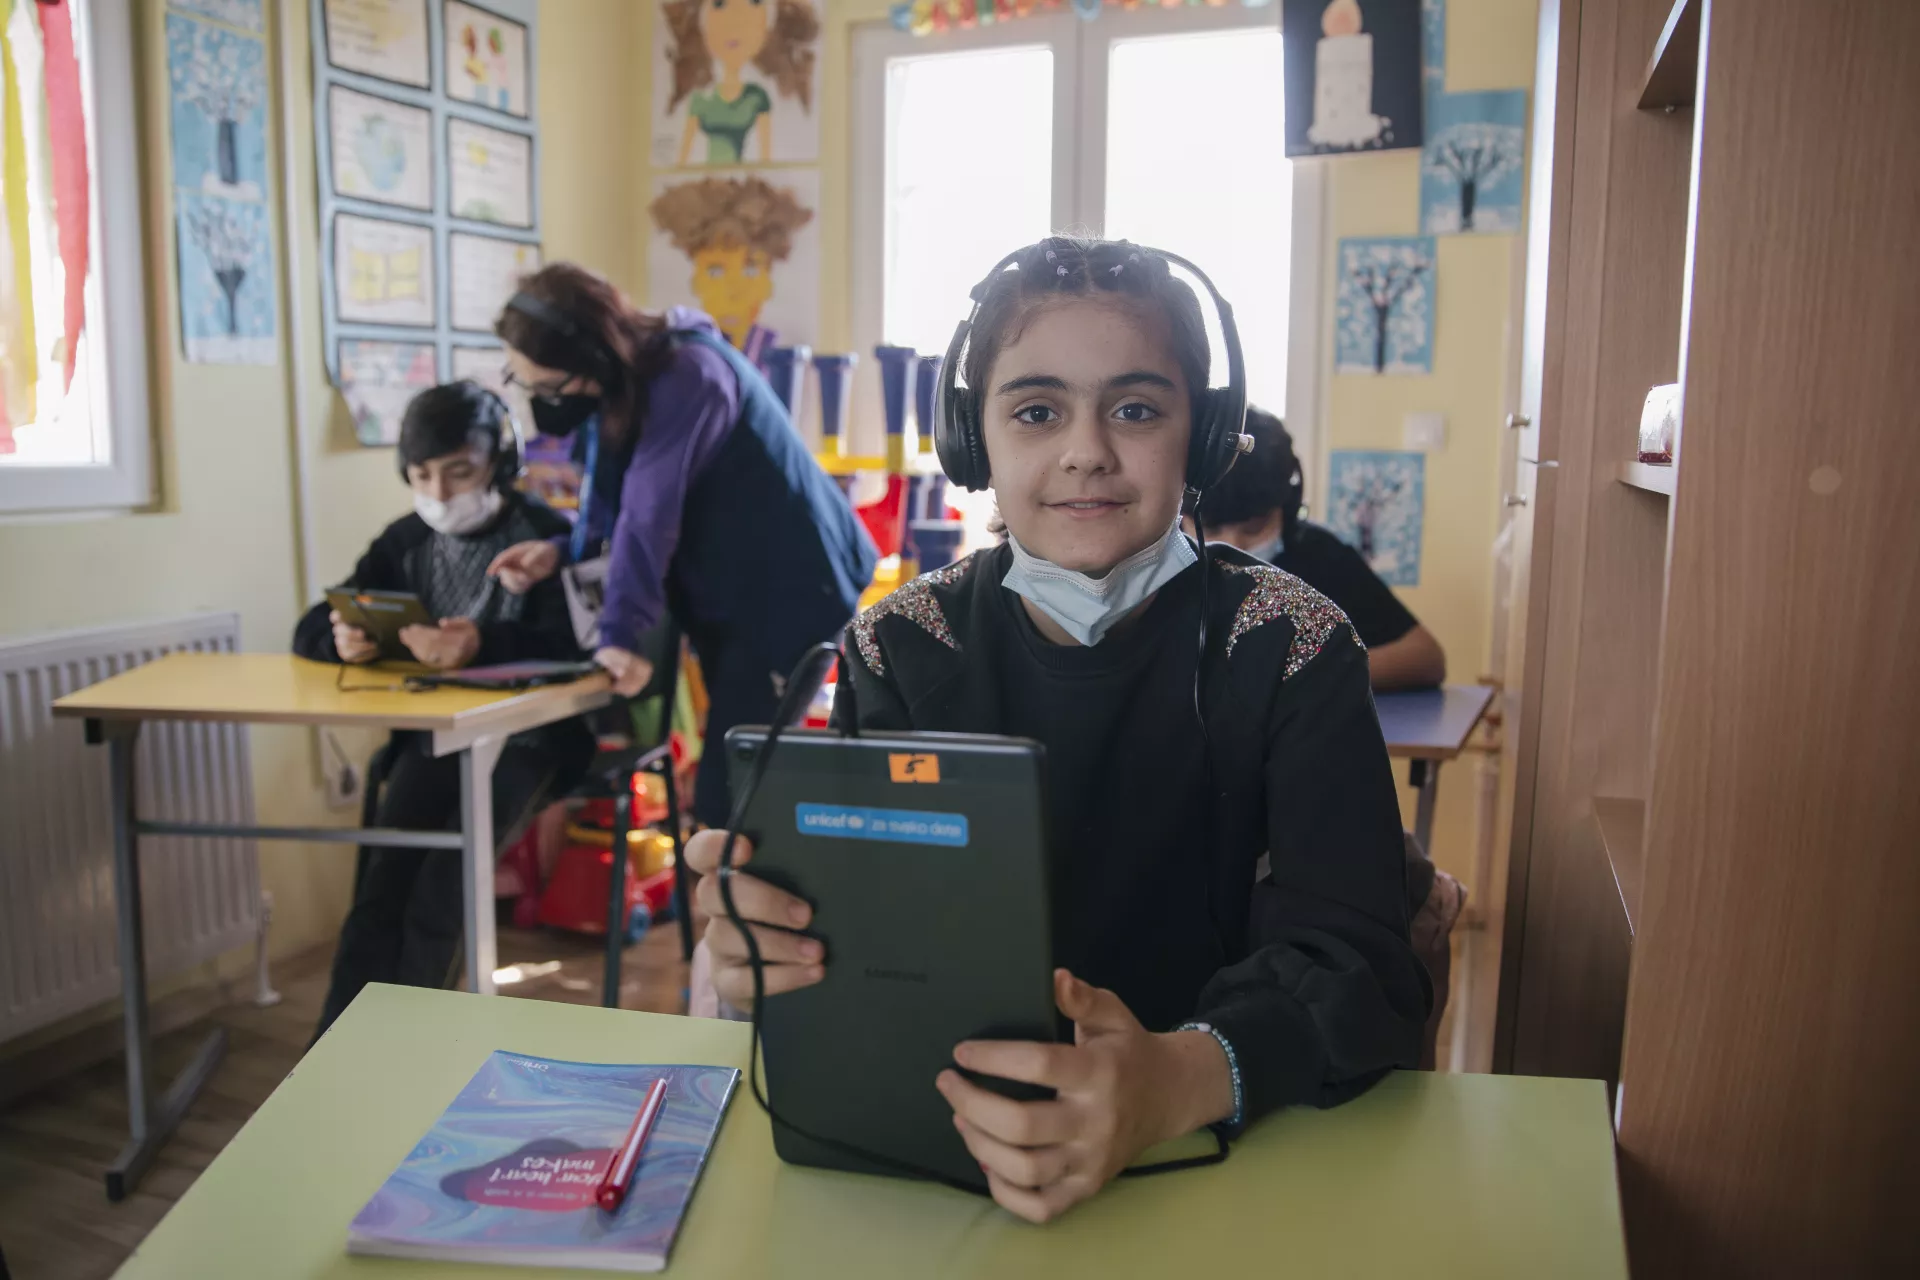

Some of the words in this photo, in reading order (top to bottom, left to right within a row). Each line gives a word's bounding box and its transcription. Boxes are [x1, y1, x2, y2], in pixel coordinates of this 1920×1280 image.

[803, 813, 846, 828] unicef
[521, 1156, 596, 1173] makes
[489, 1167, 552, 1186] heart
[555, 1171, 604, 1186] your
